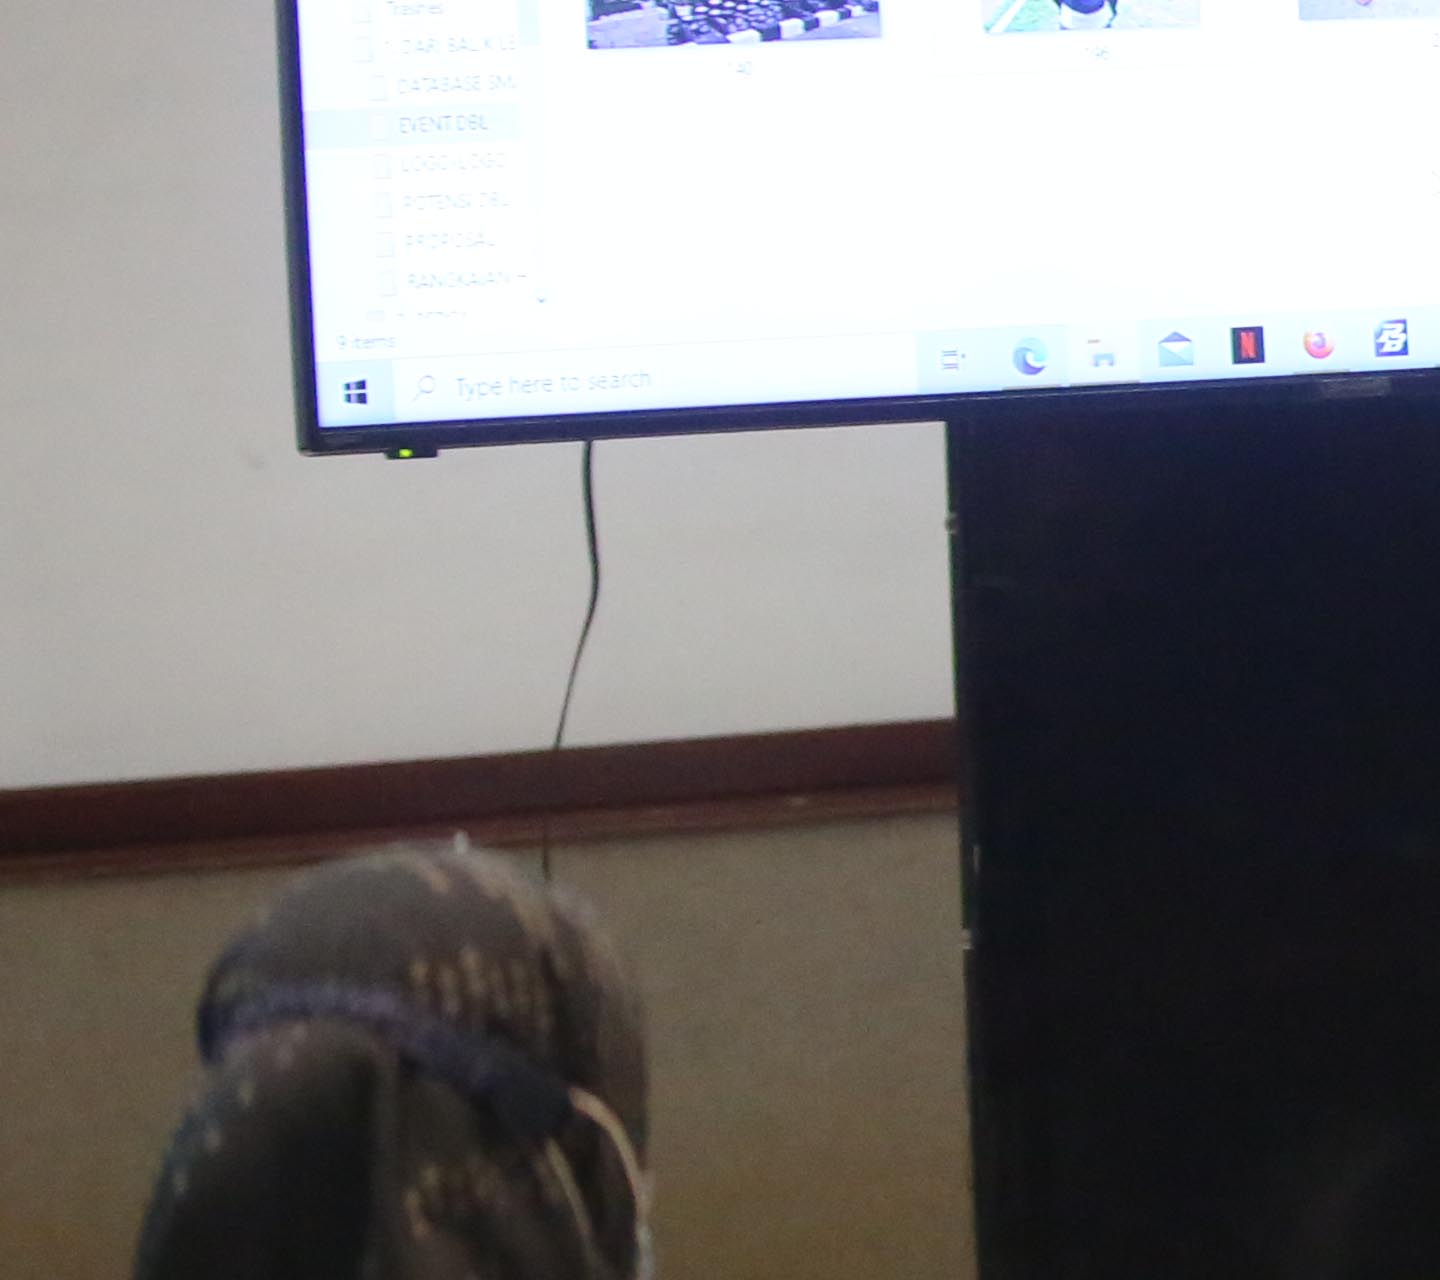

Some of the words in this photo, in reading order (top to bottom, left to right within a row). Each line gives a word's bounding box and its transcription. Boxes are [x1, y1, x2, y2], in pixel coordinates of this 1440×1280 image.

[455, 376, 503, 401] Type
[508, 372, 554, 394] here
[587, 368, 653, 391] search
